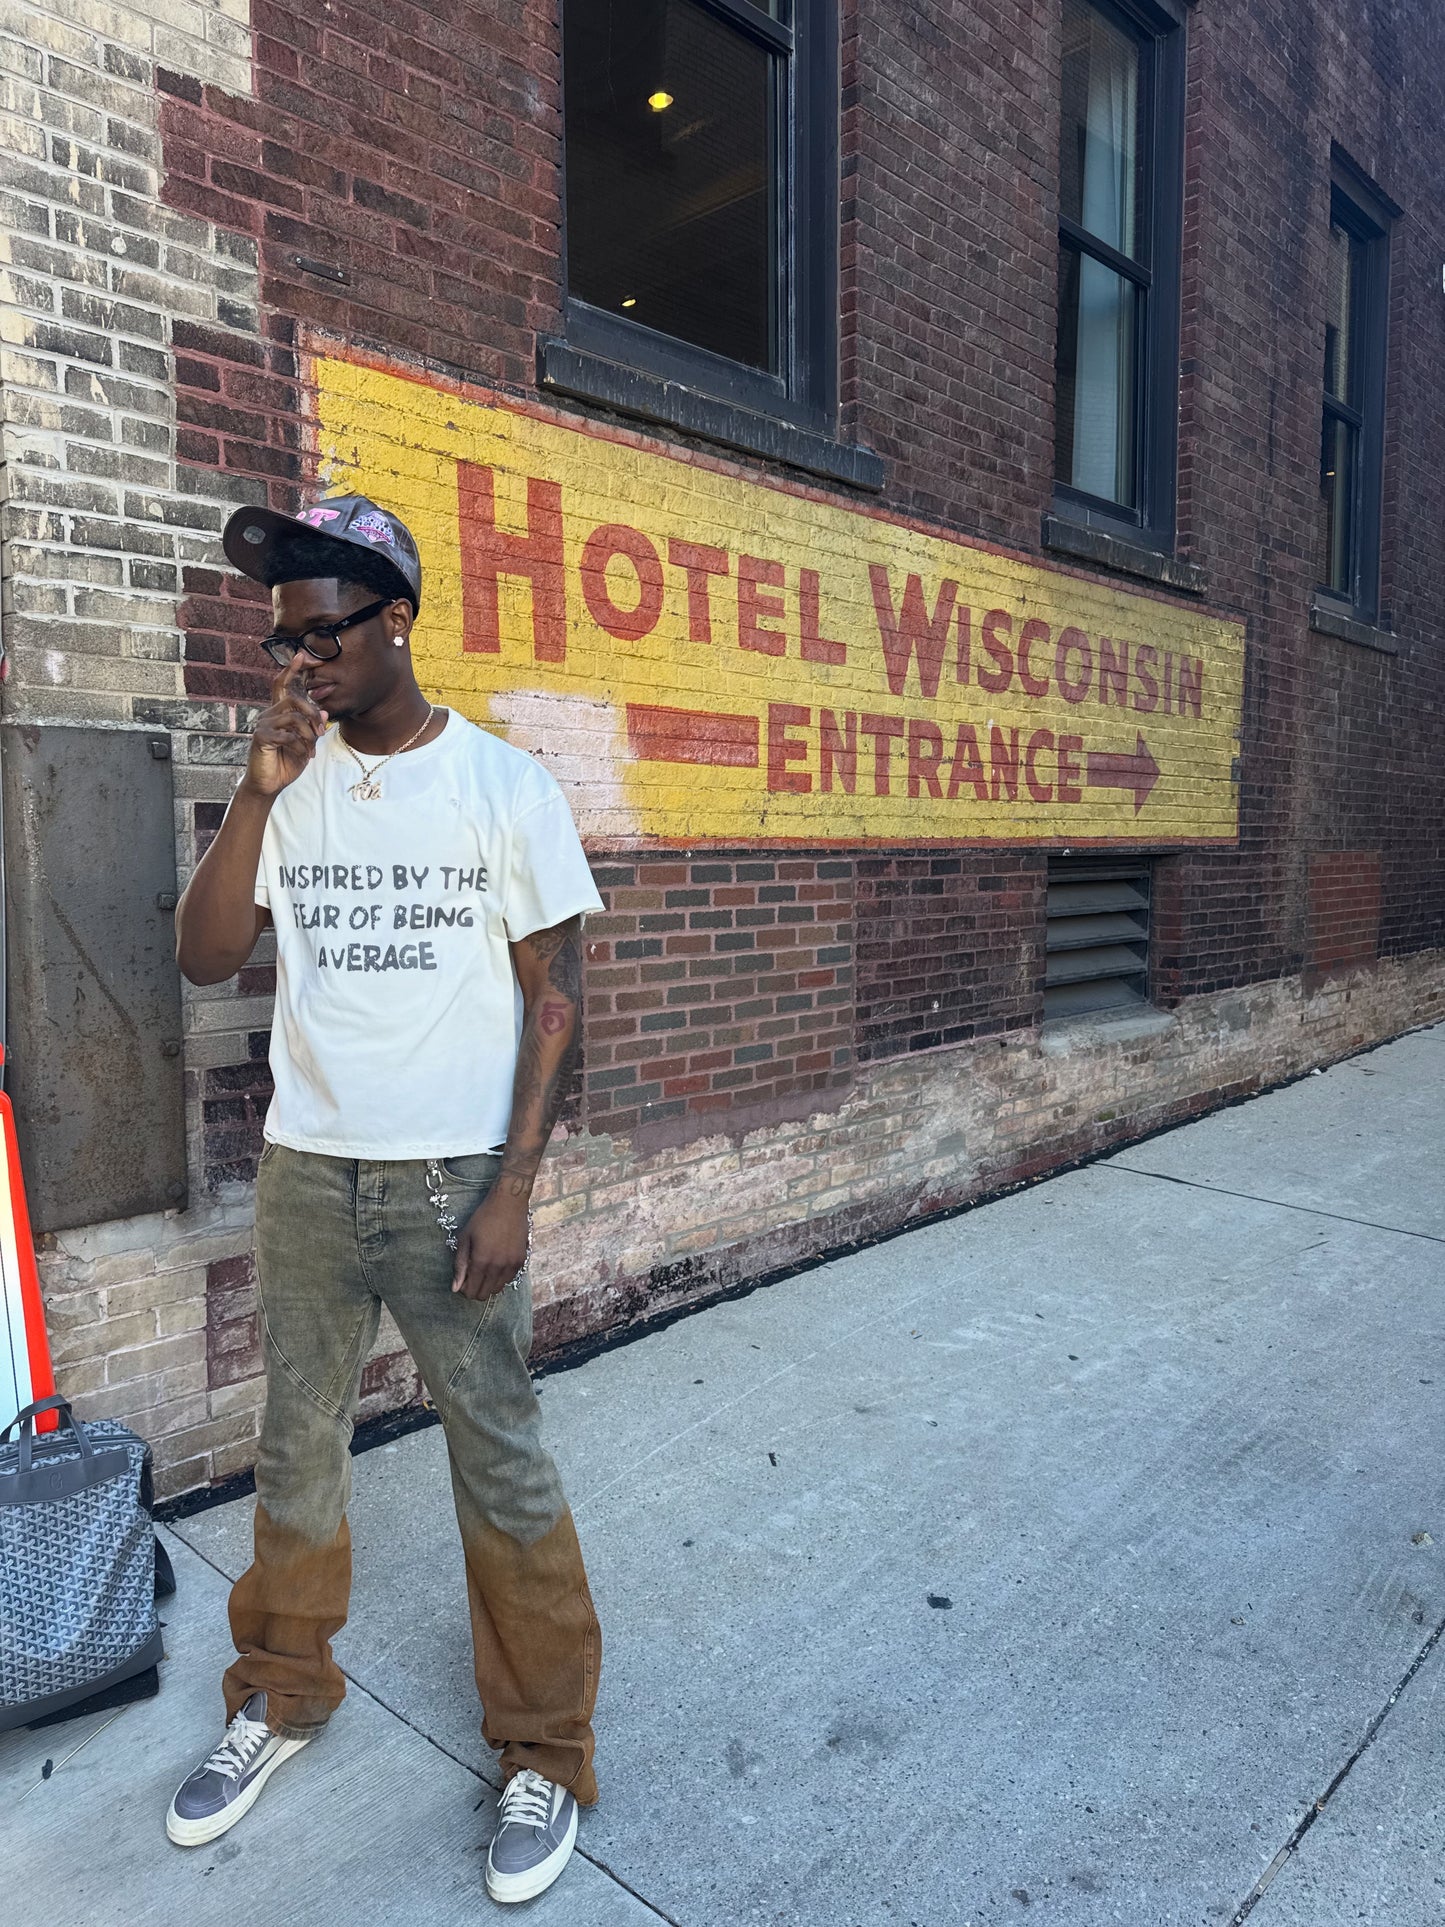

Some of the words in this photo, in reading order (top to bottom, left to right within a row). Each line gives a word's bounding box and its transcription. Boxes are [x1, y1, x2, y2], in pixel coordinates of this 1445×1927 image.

[457, 459, 847, 665] HOTEL
[868, 564, 1203, 719] WISCONSIN
[767, 702, 1084, 803] ENTRANCE
[279, 864, 383, 890] INSPIRED
[392, 864, 429, 890] BY
[439, 866, 488, 892] THE
[293, 903, 340, 929] FEAR
[349, 904, 382, 930] OF
[393, 903, 474, 930] BEING
[318, 941, 437, 972] AVERAGE
